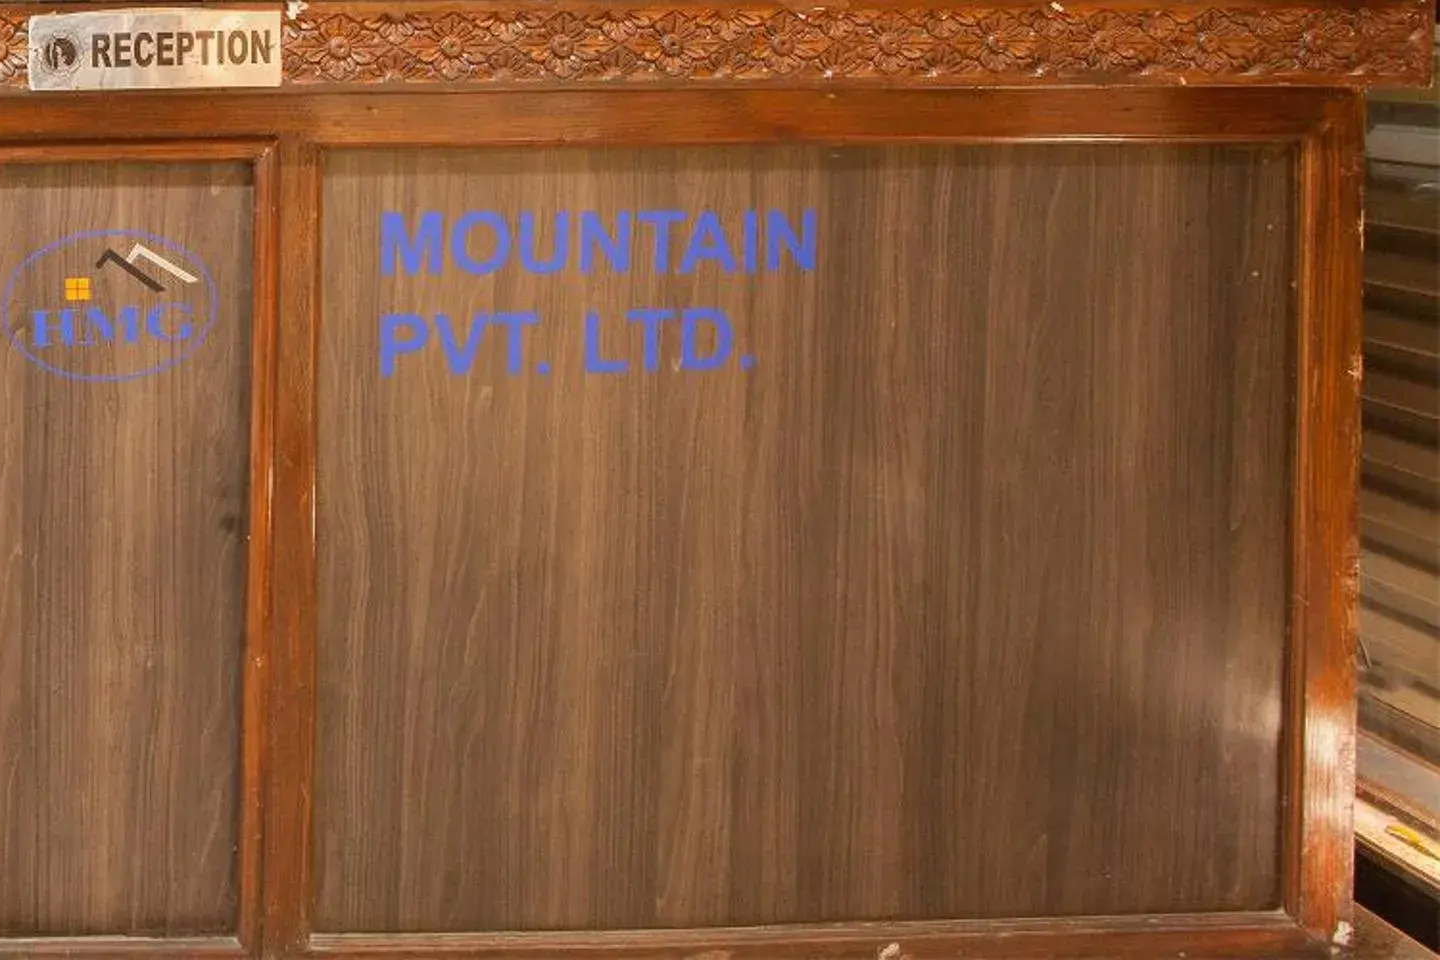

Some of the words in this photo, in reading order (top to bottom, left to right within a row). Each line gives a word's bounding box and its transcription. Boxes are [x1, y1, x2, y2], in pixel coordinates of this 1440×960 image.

[91, 29, 272, 68] RECEPTION
[379, 208, 818, 276] MOUNTAIN
[31, 301, 194, 348] HMG
[378, 310, 551, 377] PVT.
[583, 306, 758, 374] LTD.
